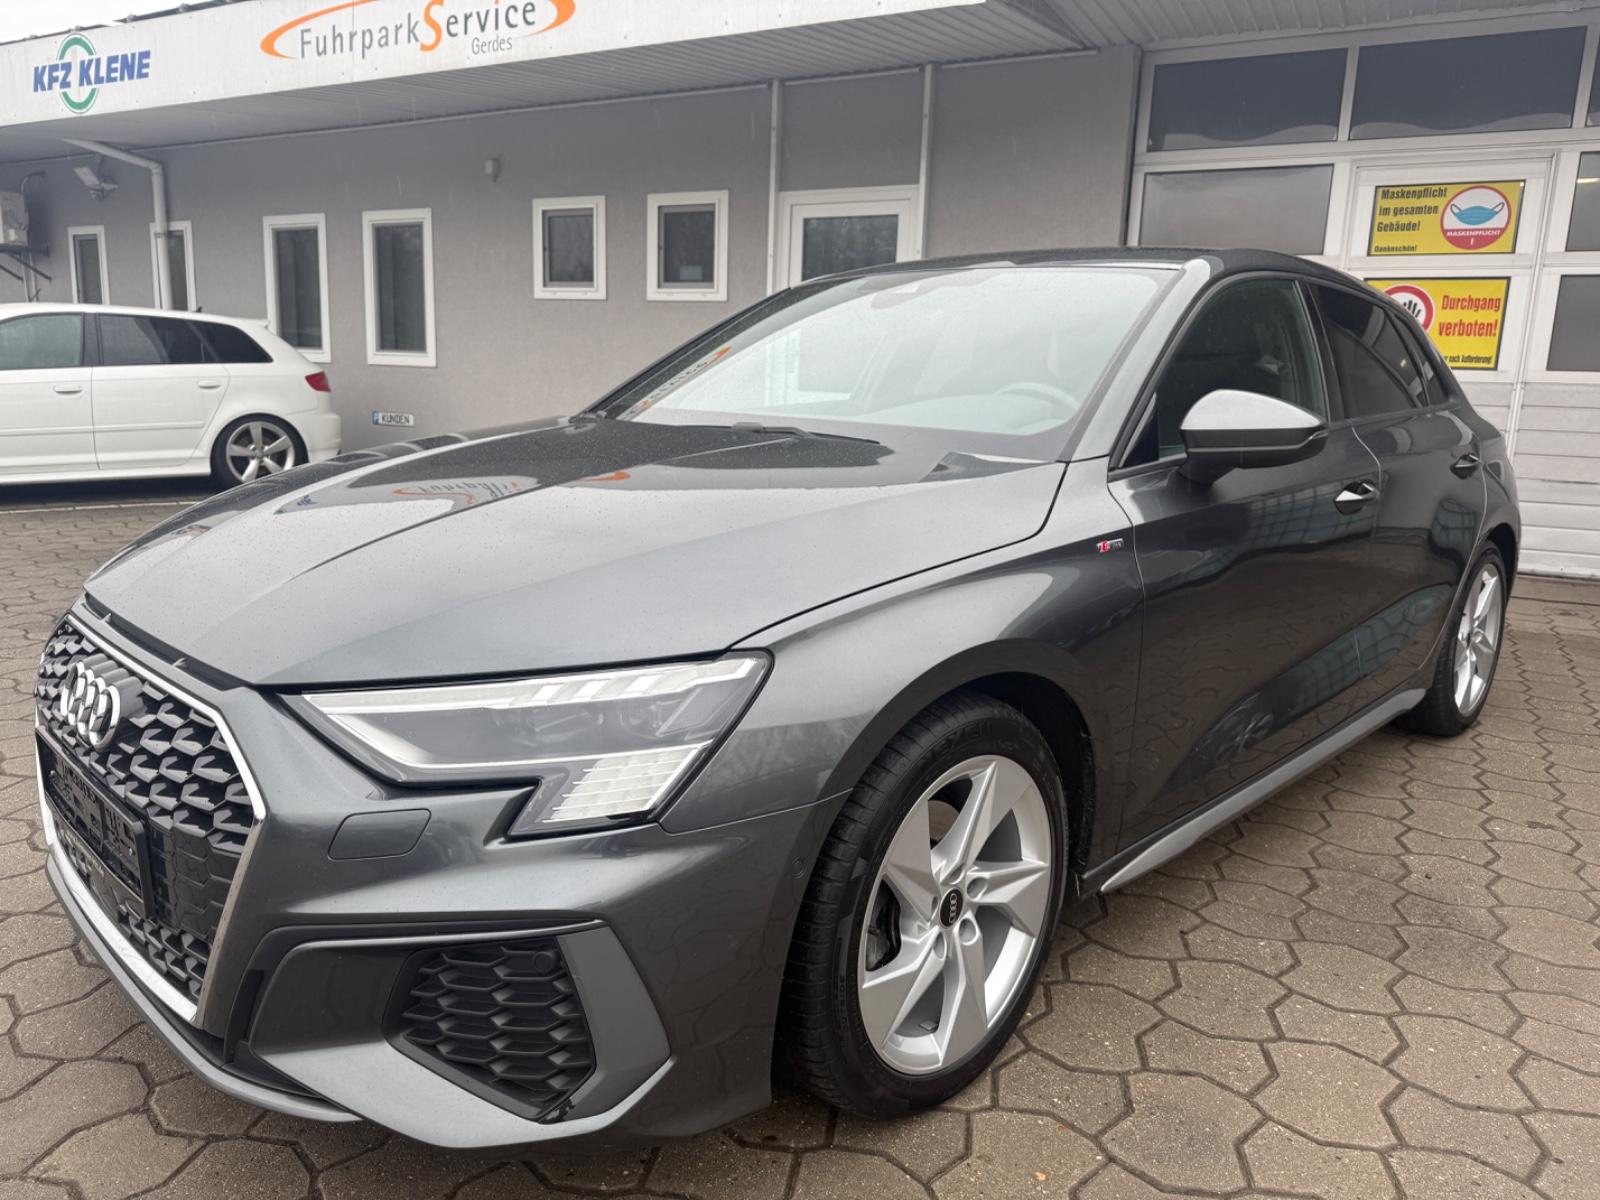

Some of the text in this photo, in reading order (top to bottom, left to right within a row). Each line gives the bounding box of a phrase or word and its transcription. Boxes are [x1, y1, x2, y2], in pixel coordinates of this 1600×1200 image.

[471, 36, 513, 55] Gerdes
[33, 50, 151, 92] KFZ KLENE
[1381, 186, 1448, 200] Maskenpflicht
[1392, 204, 1439, 216] gesamten
[1377, 220, 1421, 233] Gebäude!
[1446, 229, 1501, 237] MASKENPFLICHT
[1441, 295, 1501, 312] Durchgang
[1438, 319, 1498, 337] verboten!
[381, 414, 410, 424] KUNDEN
